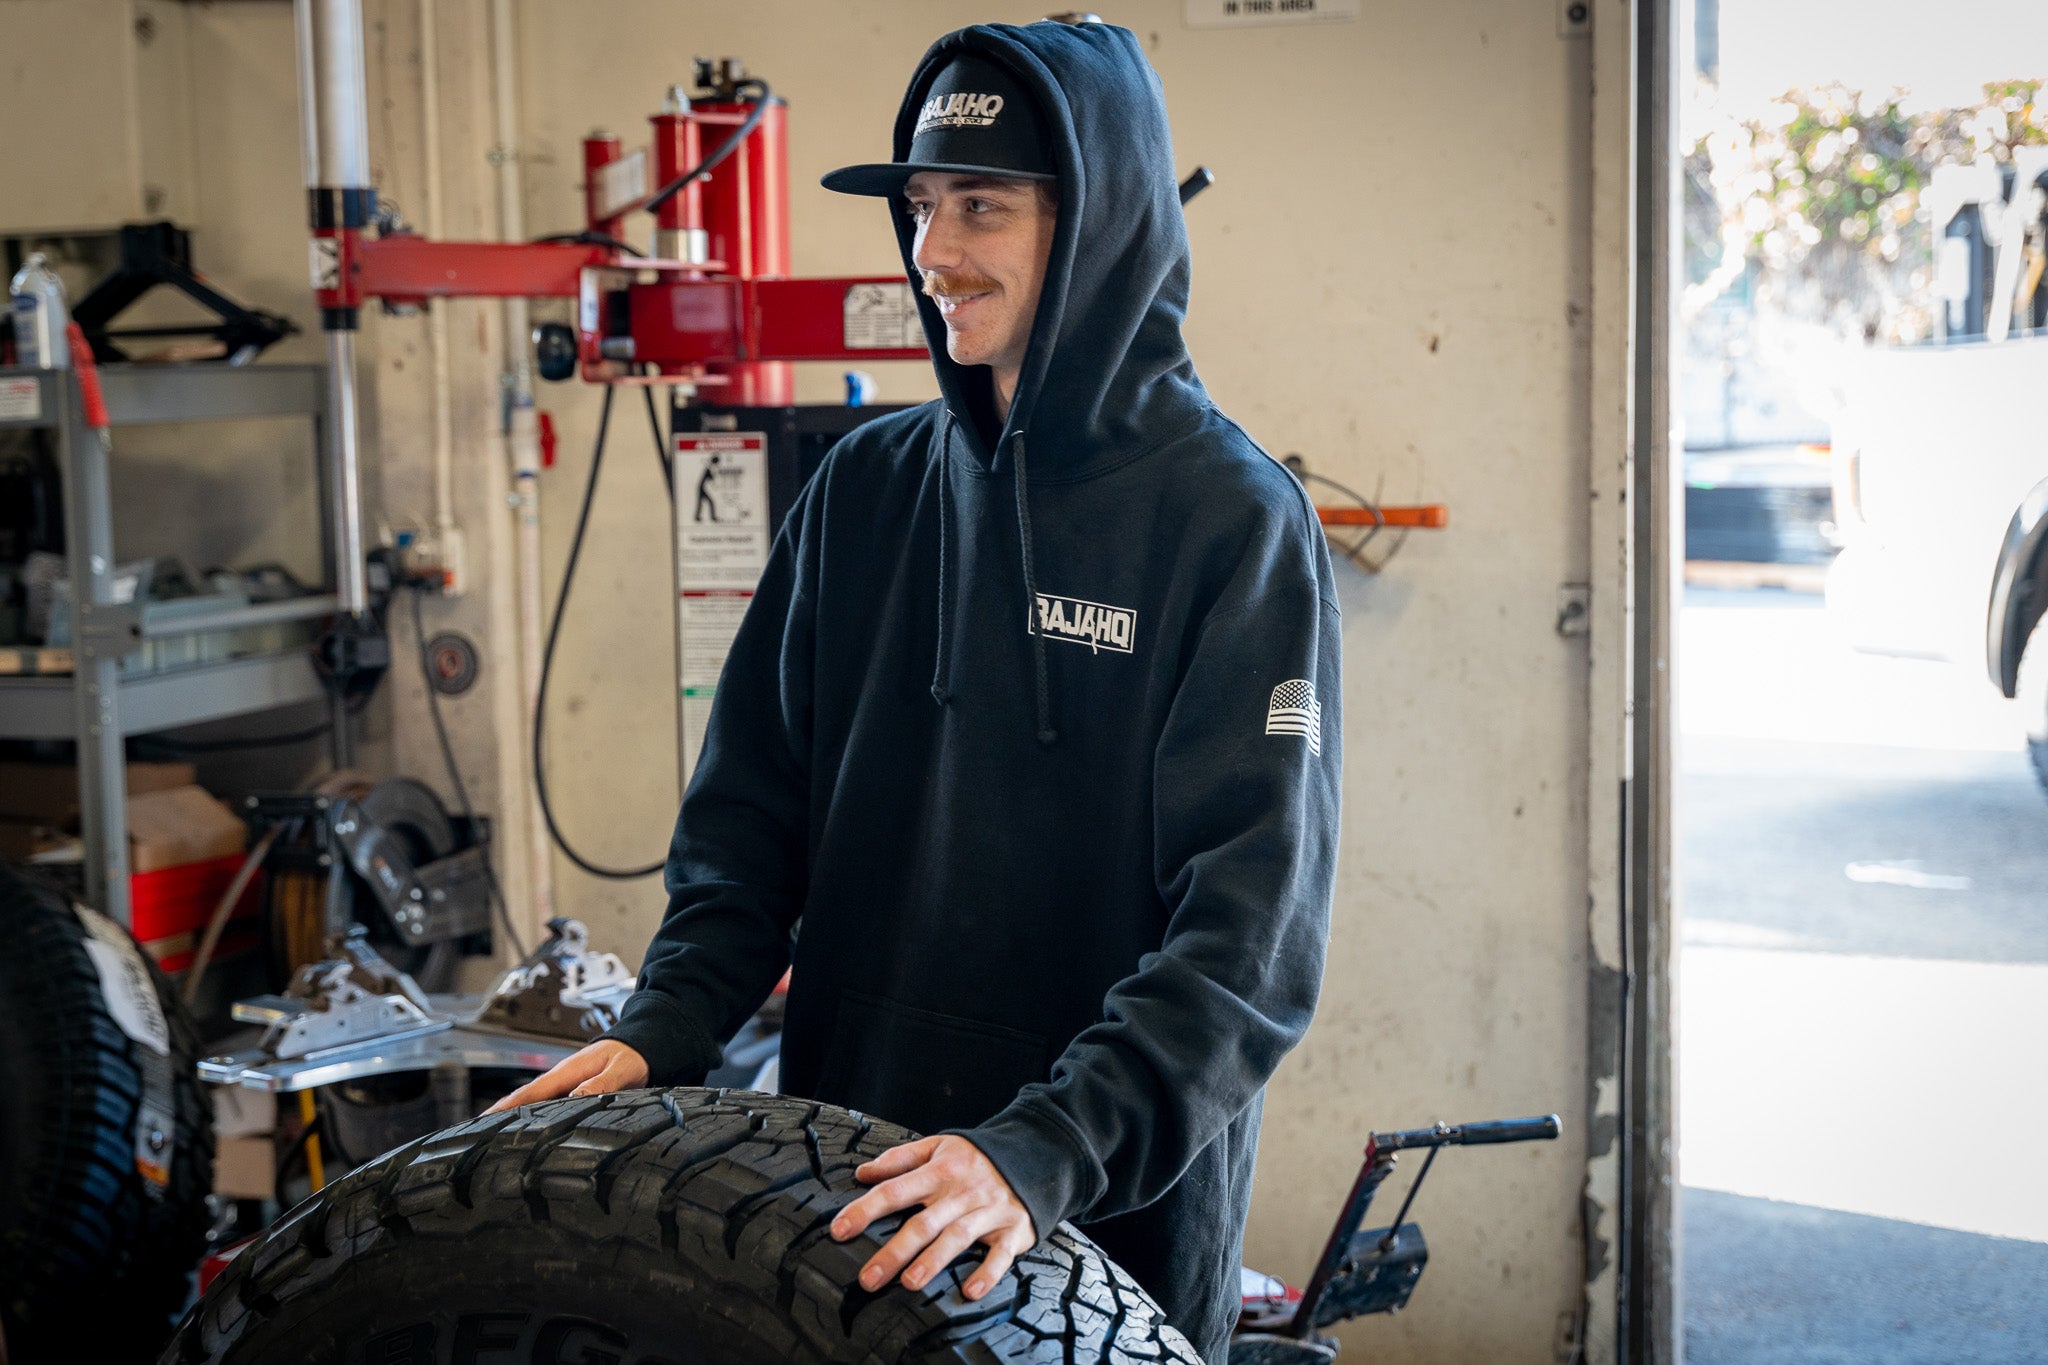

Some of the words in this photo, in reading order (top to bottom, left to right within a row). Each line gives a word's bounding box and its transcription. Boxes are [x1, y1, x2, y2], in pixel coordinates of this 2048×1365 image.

[1225, 1, 1239, 14] IN
[1245, 0, 1273, 13] THIS
[1279, 0, 1315, 12] AREA
[364, 1313, 672, 1365] BFG
